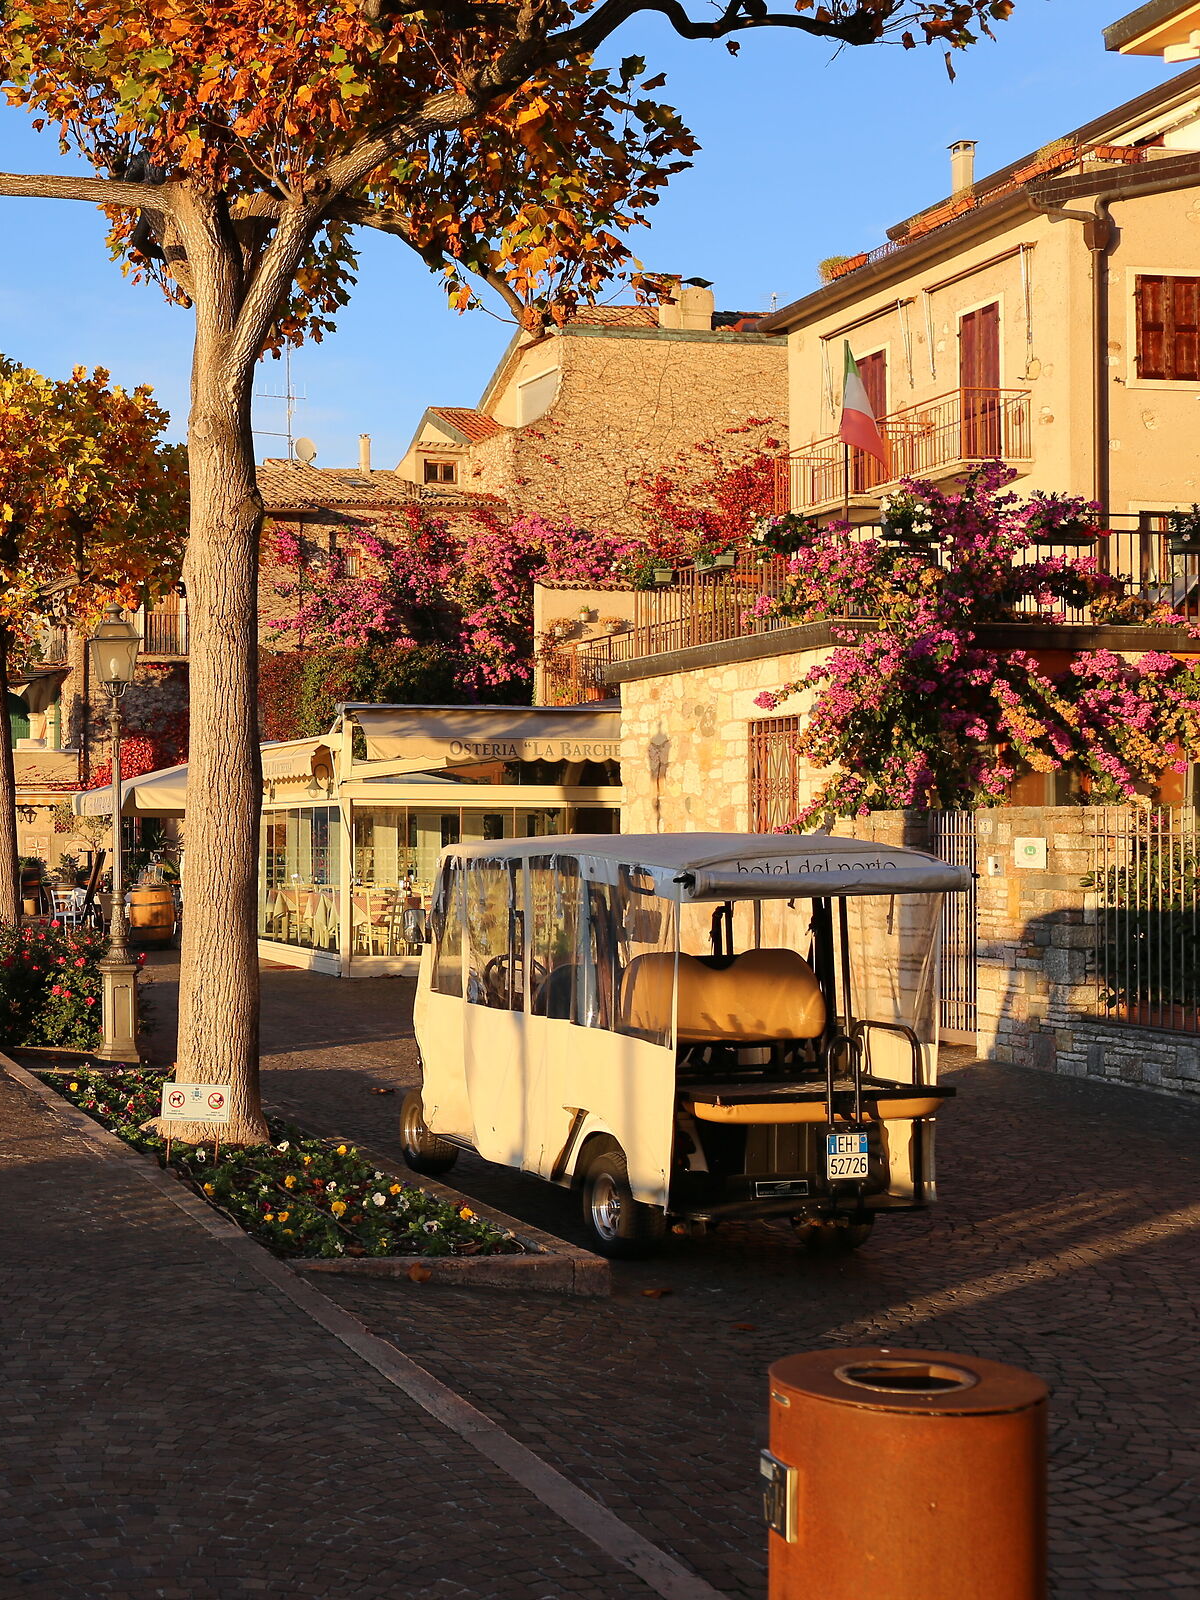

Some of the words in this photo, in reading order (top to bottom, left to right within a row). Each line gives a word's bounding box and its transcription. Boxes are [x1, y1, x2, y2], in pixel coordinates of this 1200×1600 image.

[450, 740, 517, 756] OSTERIA
[838, 1136, 853, 1153] EH
[831, 1157, 867, 1175] 52726
